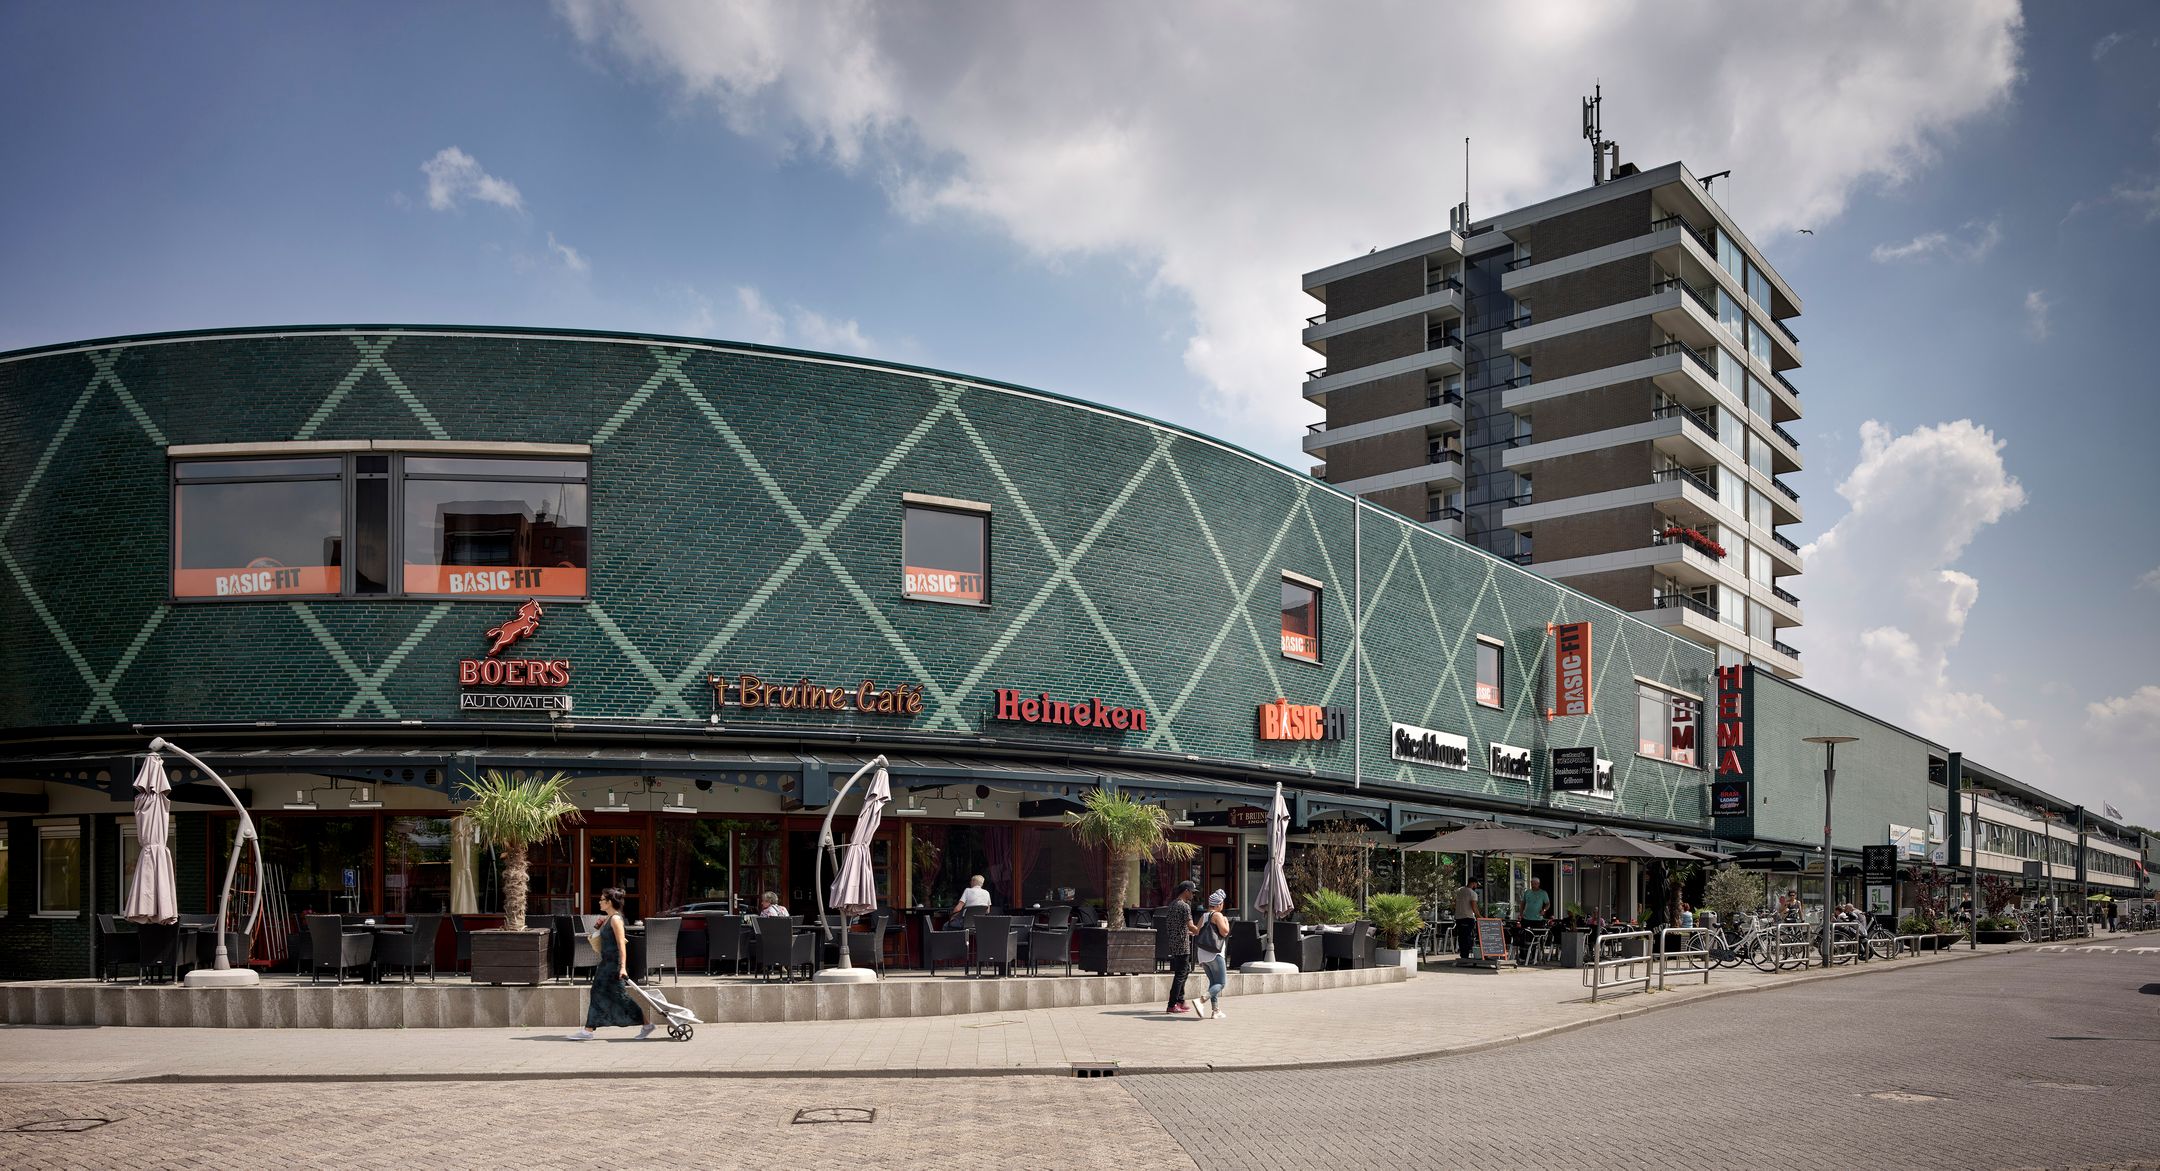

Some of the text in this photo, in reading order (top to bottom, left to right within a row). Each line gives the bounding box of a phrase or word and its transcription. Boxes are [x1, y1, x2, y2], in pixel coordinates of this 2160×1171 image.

[216, 568, 301, 595] BASIC-FIT
[449, 568, 543, 593] BASIC-FIT
[905, 573, 982, 593] BASIC-FIT
[460, 659, 570, 687] BOERS
[1560, 624, 1586, 715] BASIC-FIT
[462, 694, 566, 710] AUTOMATEN
[708, 672, 925, 714] 't Bruine Café
[995, 688, 1148, 731] Heineken
[1260, 702, 1349, 740] BASIC-FIT
[1718, 664, 1743, 775] HEMA
[1395, 728, 1466, 767] Steakhouse
